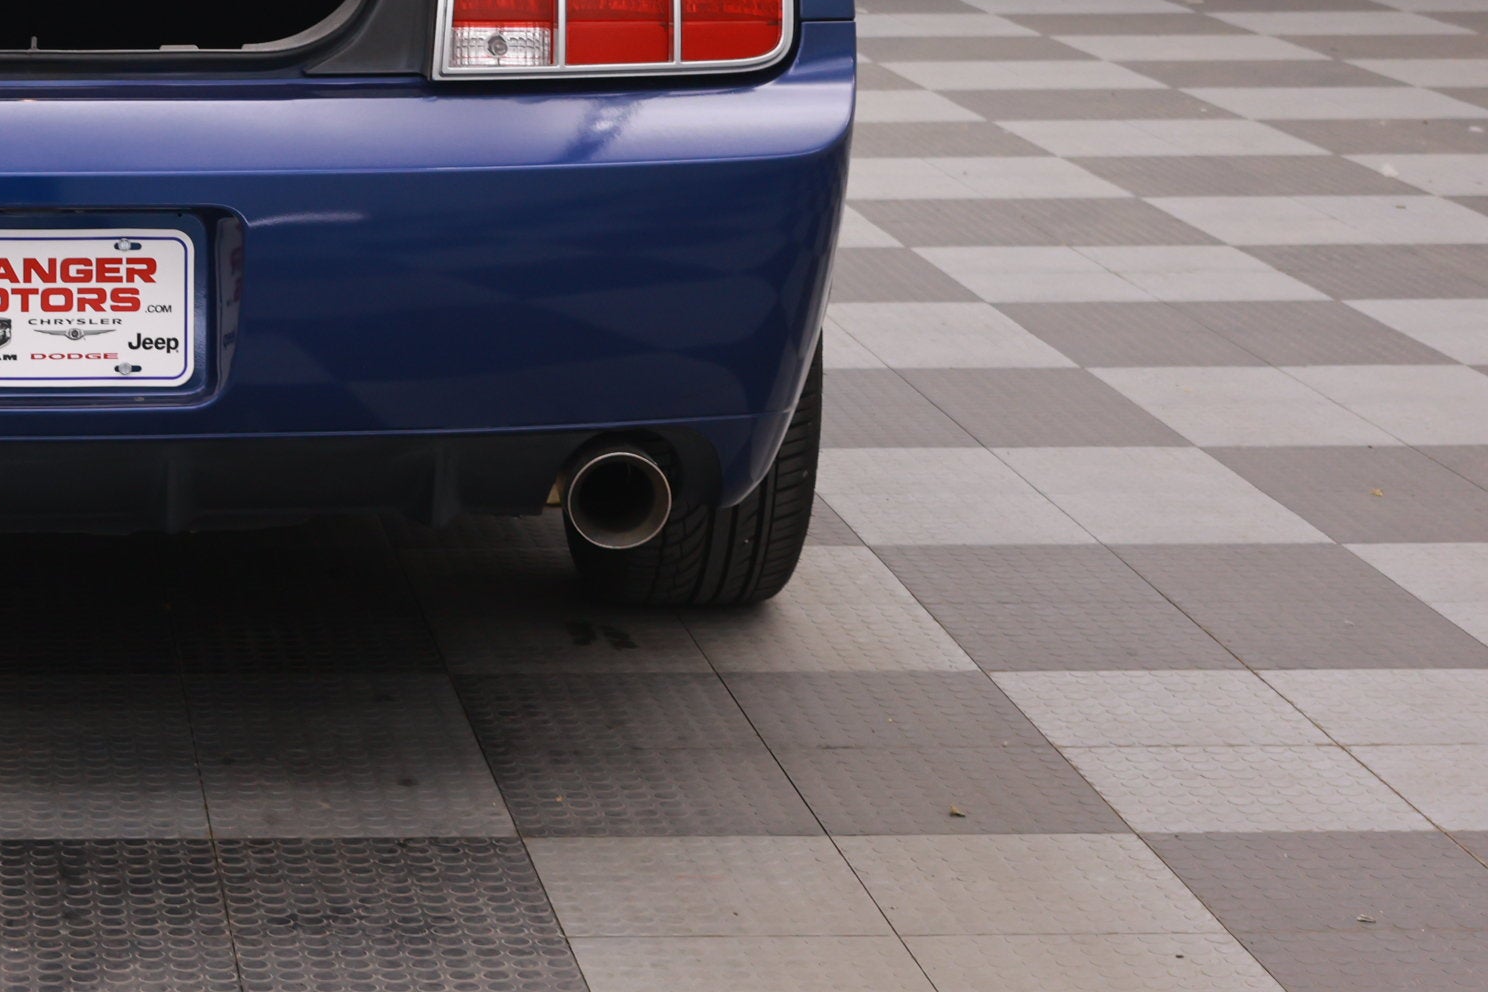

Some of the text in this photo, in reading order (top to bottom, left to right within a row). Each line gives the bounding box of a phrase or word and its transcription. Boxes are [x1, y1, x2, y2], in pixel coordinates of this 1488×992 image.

[145, 304, 172, 314] .COM
[28, 318, 123, 326] CHRYSLER
[128, 332, 179, 354] Jeep
